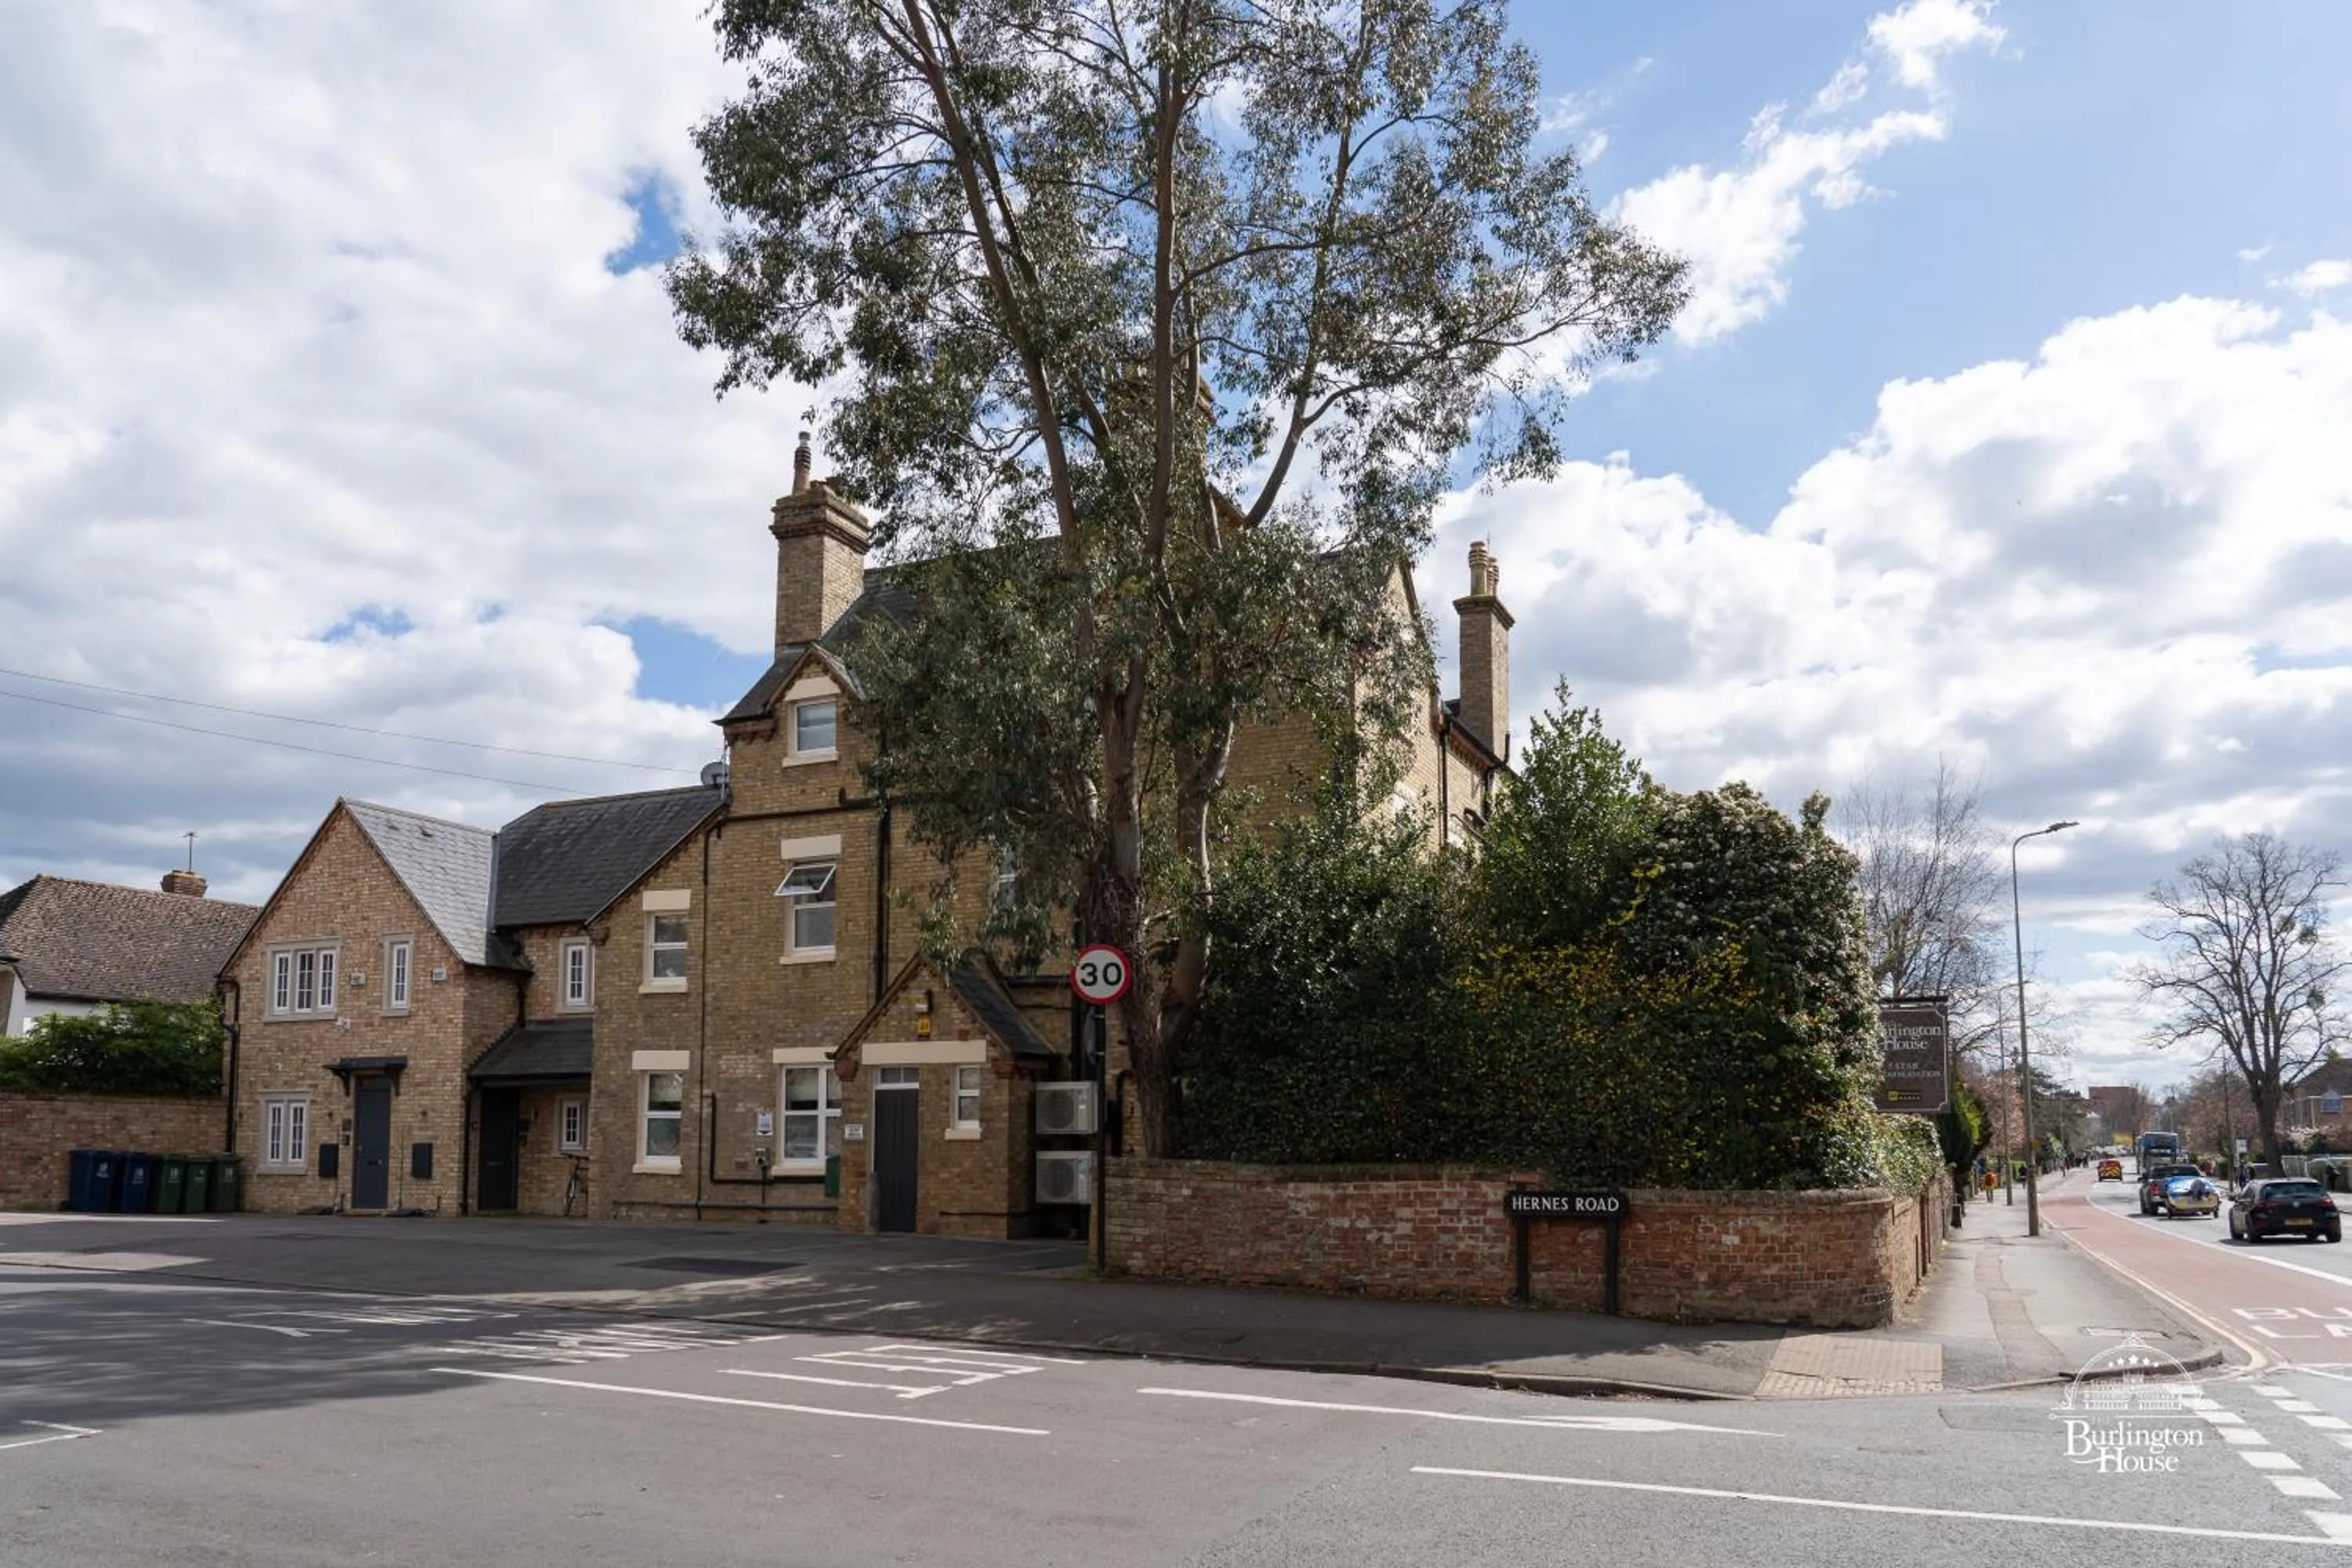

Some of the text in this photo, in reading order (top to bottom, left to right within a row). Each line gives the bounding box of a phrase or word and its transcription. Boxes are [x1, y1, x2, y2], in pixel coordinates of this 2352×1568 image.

[1080, 962, 1122, 986] 30
[1883, 1022, 1942, 1040] rlington
[1882, 1035, 1929, 1051] House
[1512, 1195, 1620, 1212] HERNES ROAD
[716, 1344, 1087, 1399] LEFT
